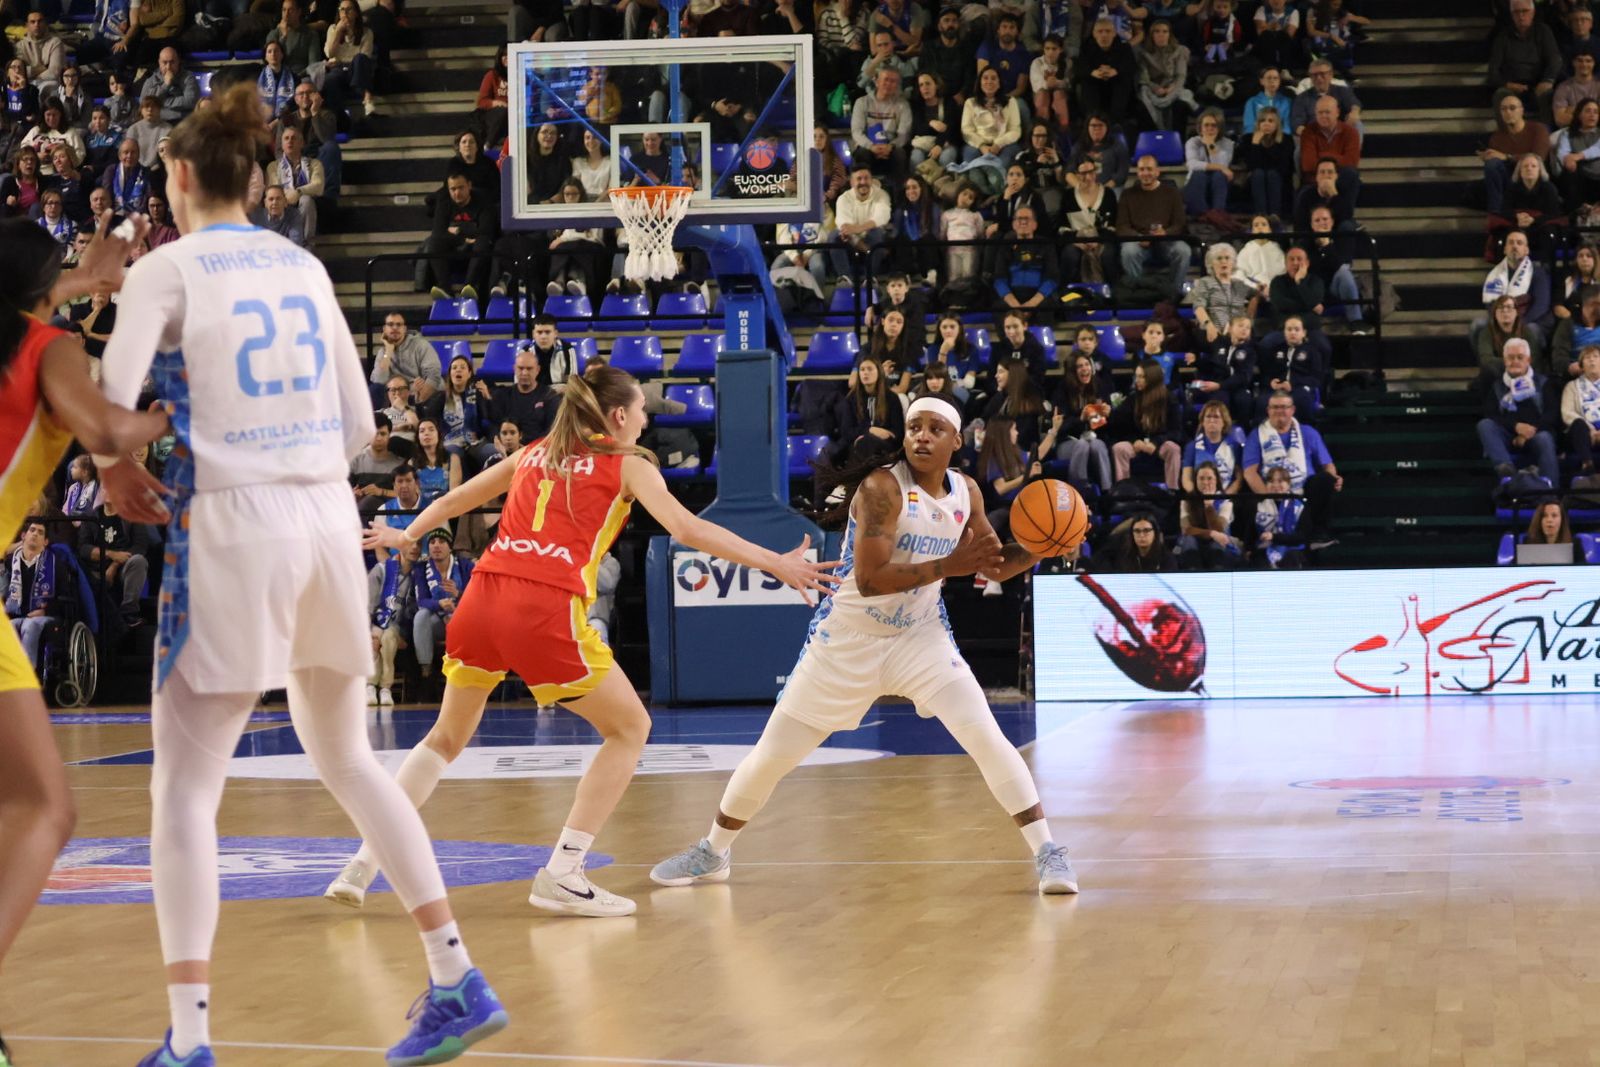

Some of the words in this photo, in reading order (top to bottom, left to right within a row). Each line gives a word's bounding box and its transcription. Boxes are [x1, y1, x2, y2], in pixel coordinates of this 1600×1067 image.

[734, 174, 791, 185] EUROCUP
[738, 184, 786, 194] WOMEN
[231, 294, 327, 398] 23
[738, 310, 749, 351] MONDO
[223, 421, 303, 444] CASTILLA
[531, 480, 556, 532] 1
[490, 535, 575, 566] NOVA
